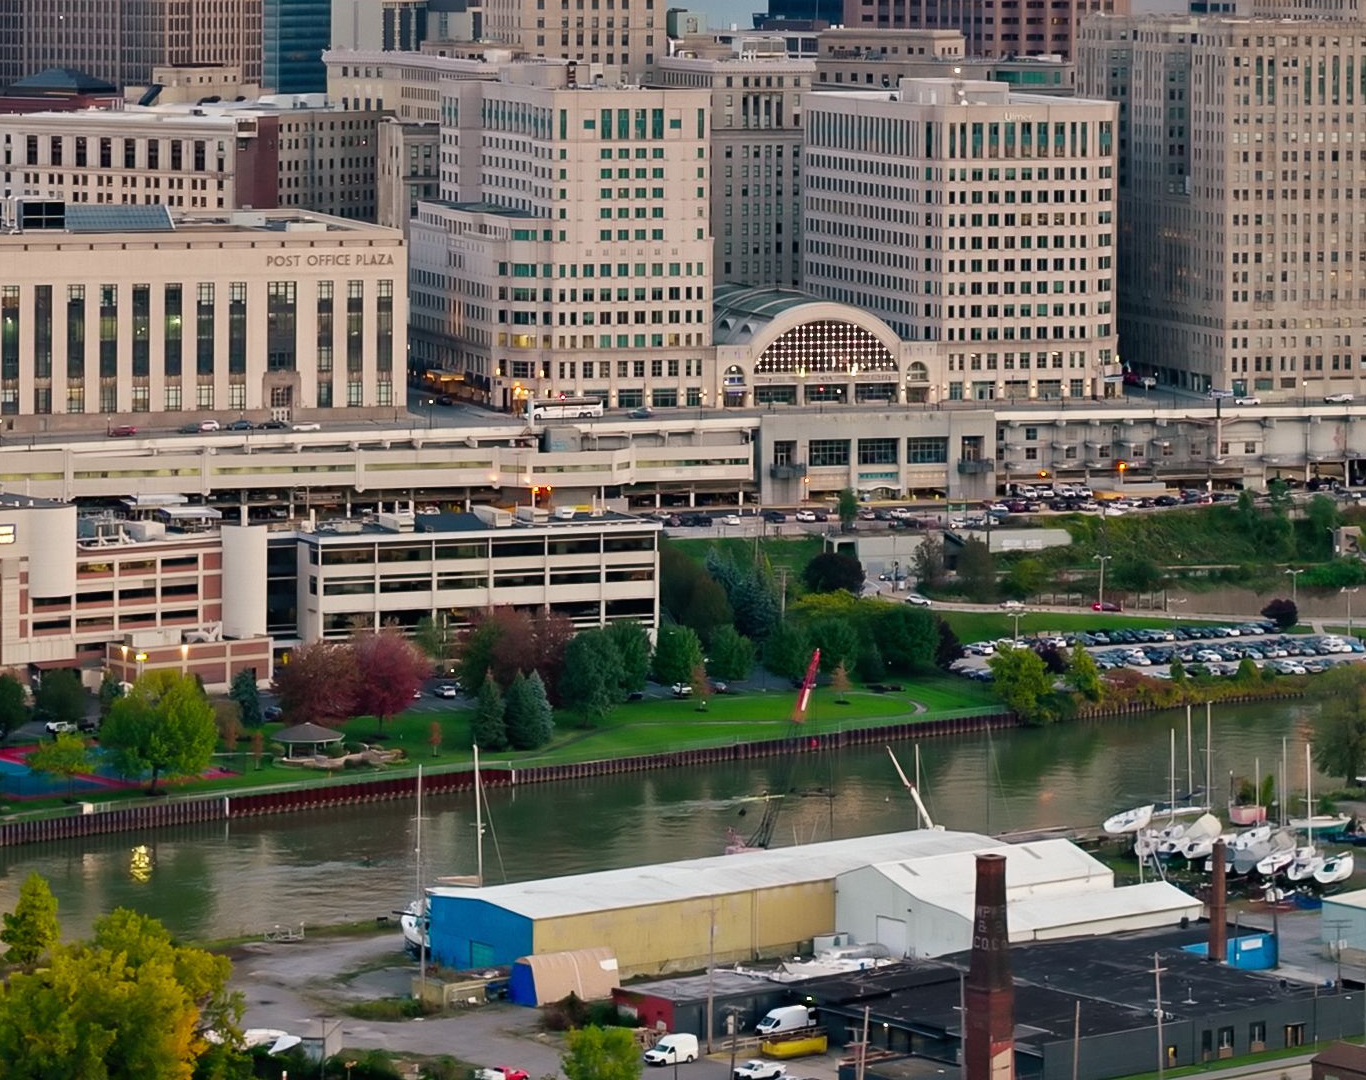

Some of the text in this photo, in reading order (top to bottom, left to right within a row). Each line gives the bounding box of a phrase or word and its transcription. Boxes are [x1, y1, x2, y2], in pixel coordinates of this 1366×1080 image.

[266, 253, 394, 267] POST OFFICE PLAZA
